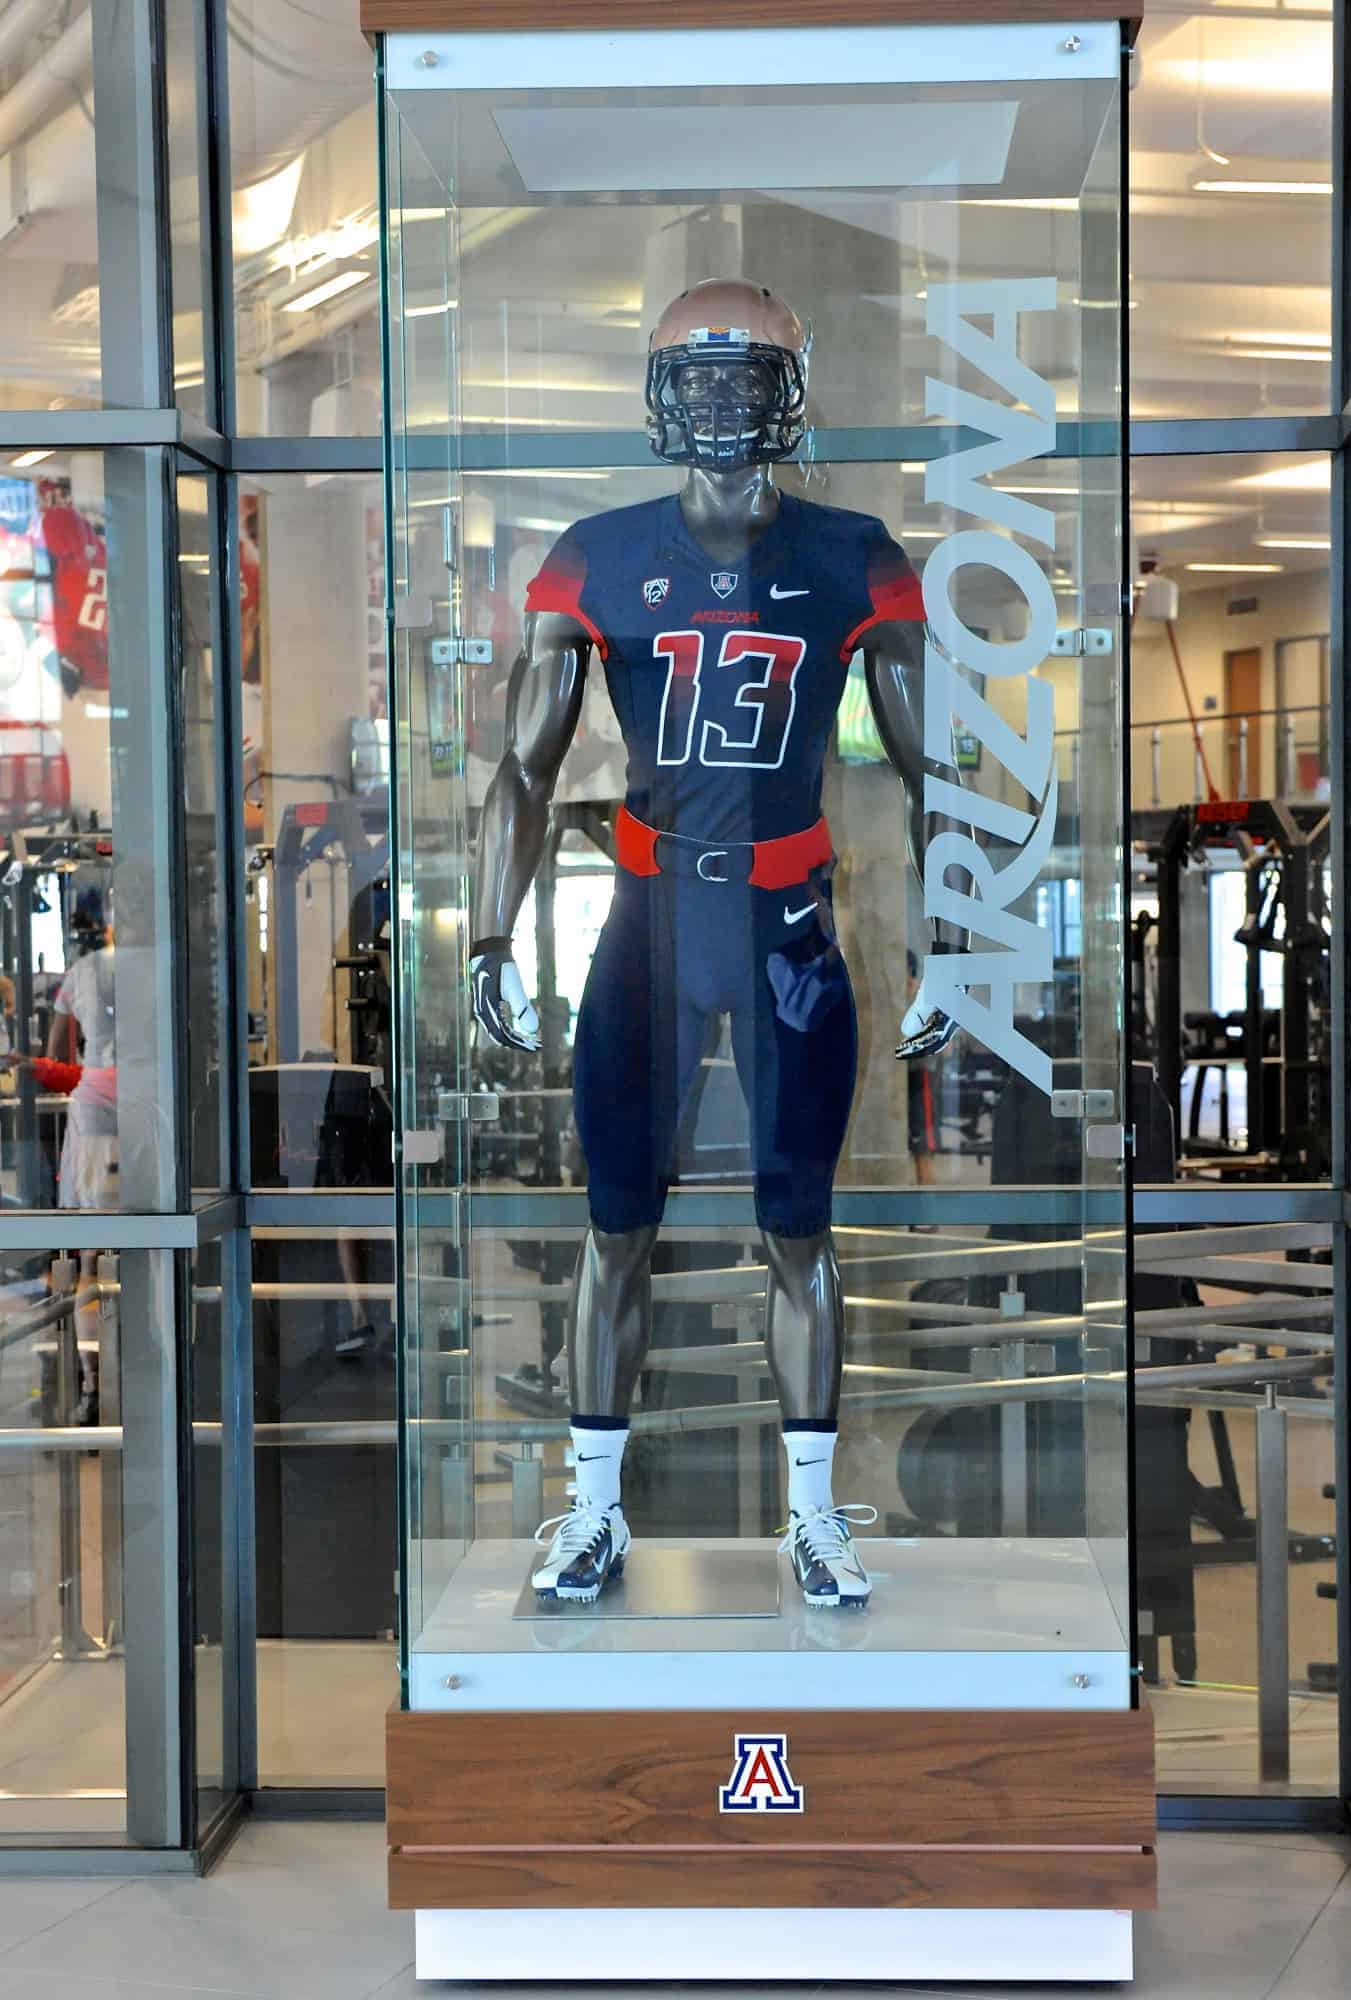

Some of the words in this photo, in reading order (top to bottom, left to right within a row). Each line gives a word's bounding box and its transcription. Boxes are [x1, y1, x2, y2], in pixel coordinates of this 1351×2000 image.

[689, 609, 760, 624] ARIZONA
[653, 630, 806, 769] 13
[922, 276, 1056, 1096] ARIZONA
[719, 1733, 804, 1813] A
